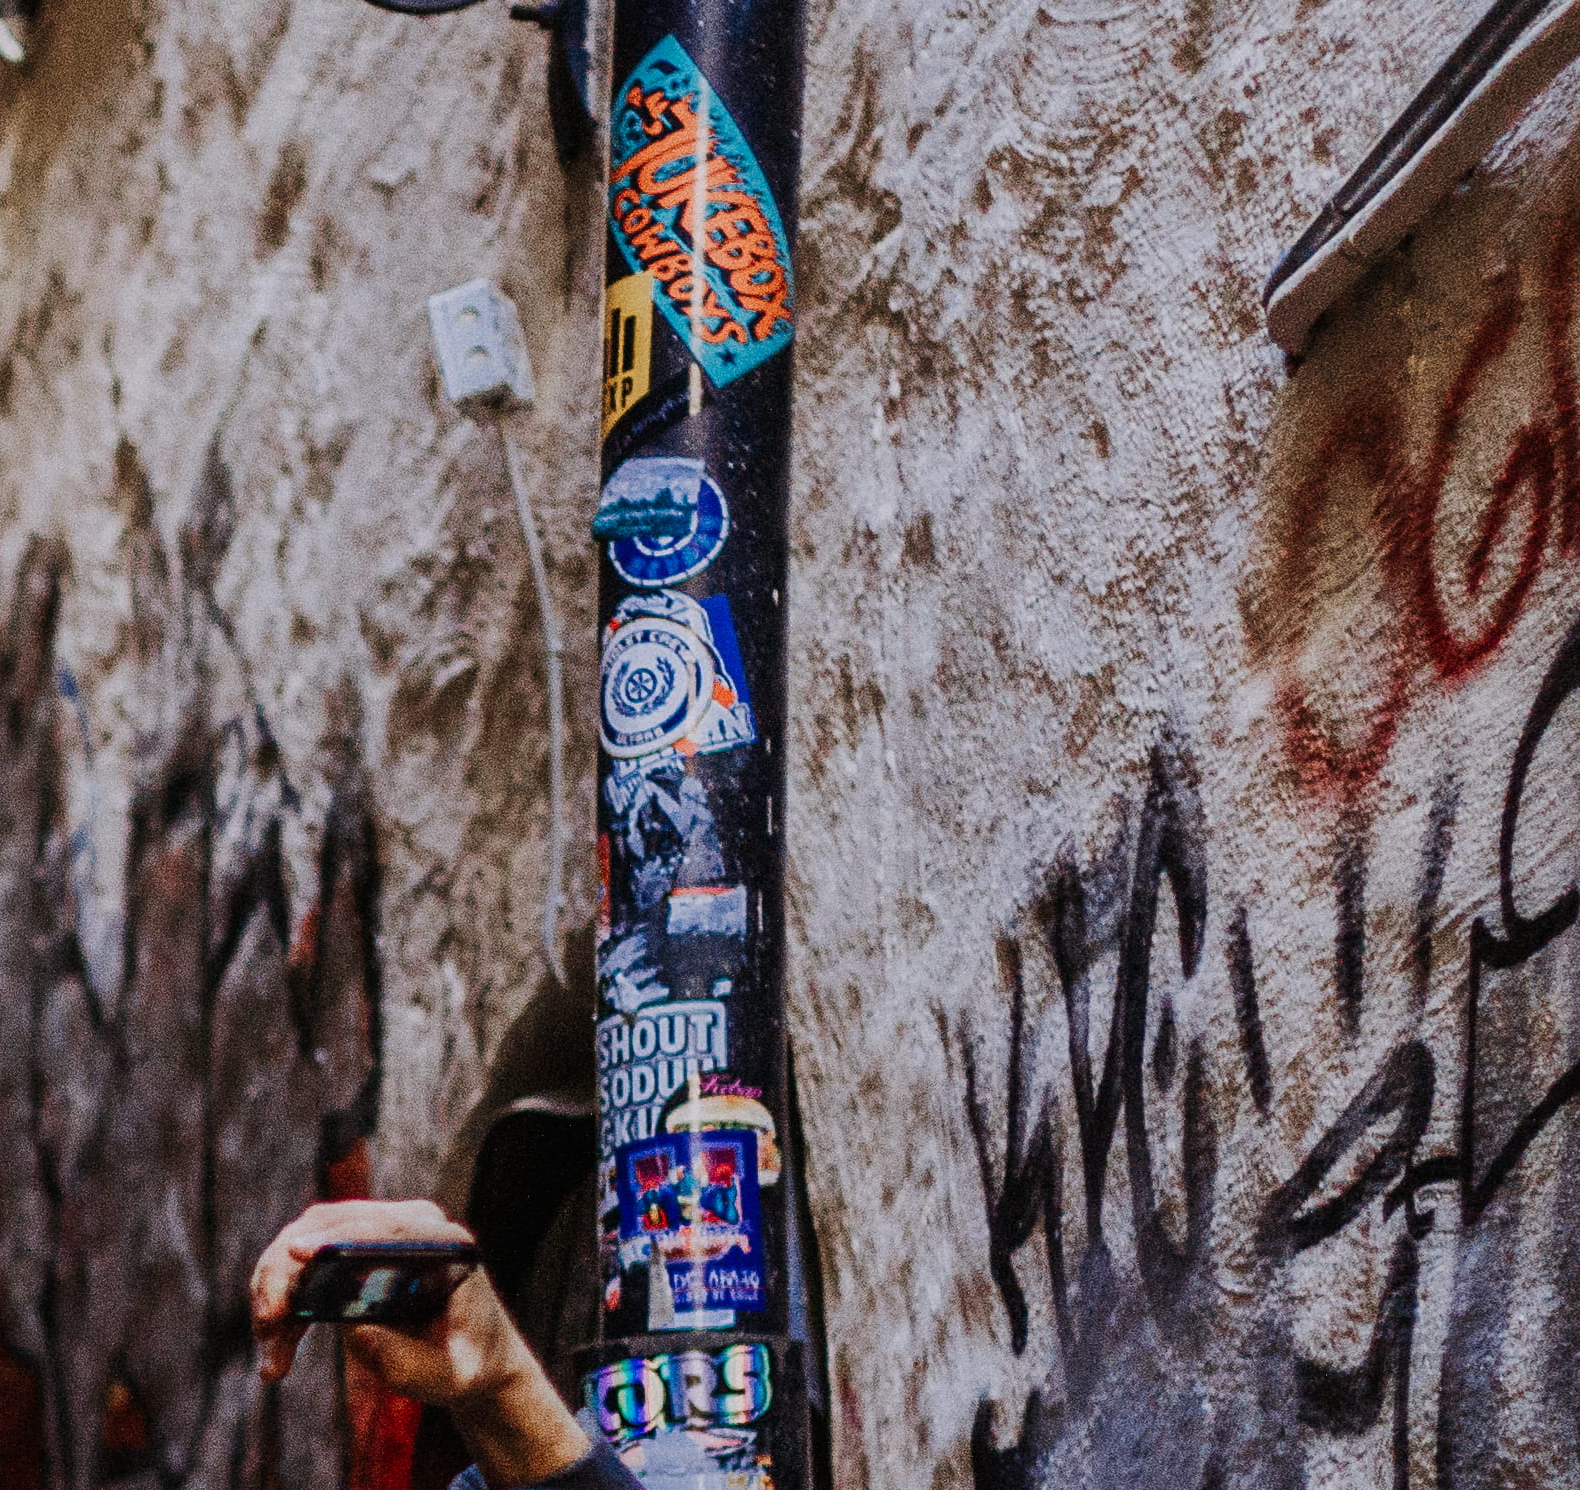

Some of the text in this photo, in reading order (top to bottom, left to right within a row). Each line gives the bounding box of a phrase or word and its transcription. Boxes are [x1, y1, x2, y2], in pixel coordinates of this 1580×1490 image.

[611, 93, 792, 341] JUKEBOX
[614, 188, 749, 345] COWBOYS
[599, 1013, 713, 1069] SHOUT
